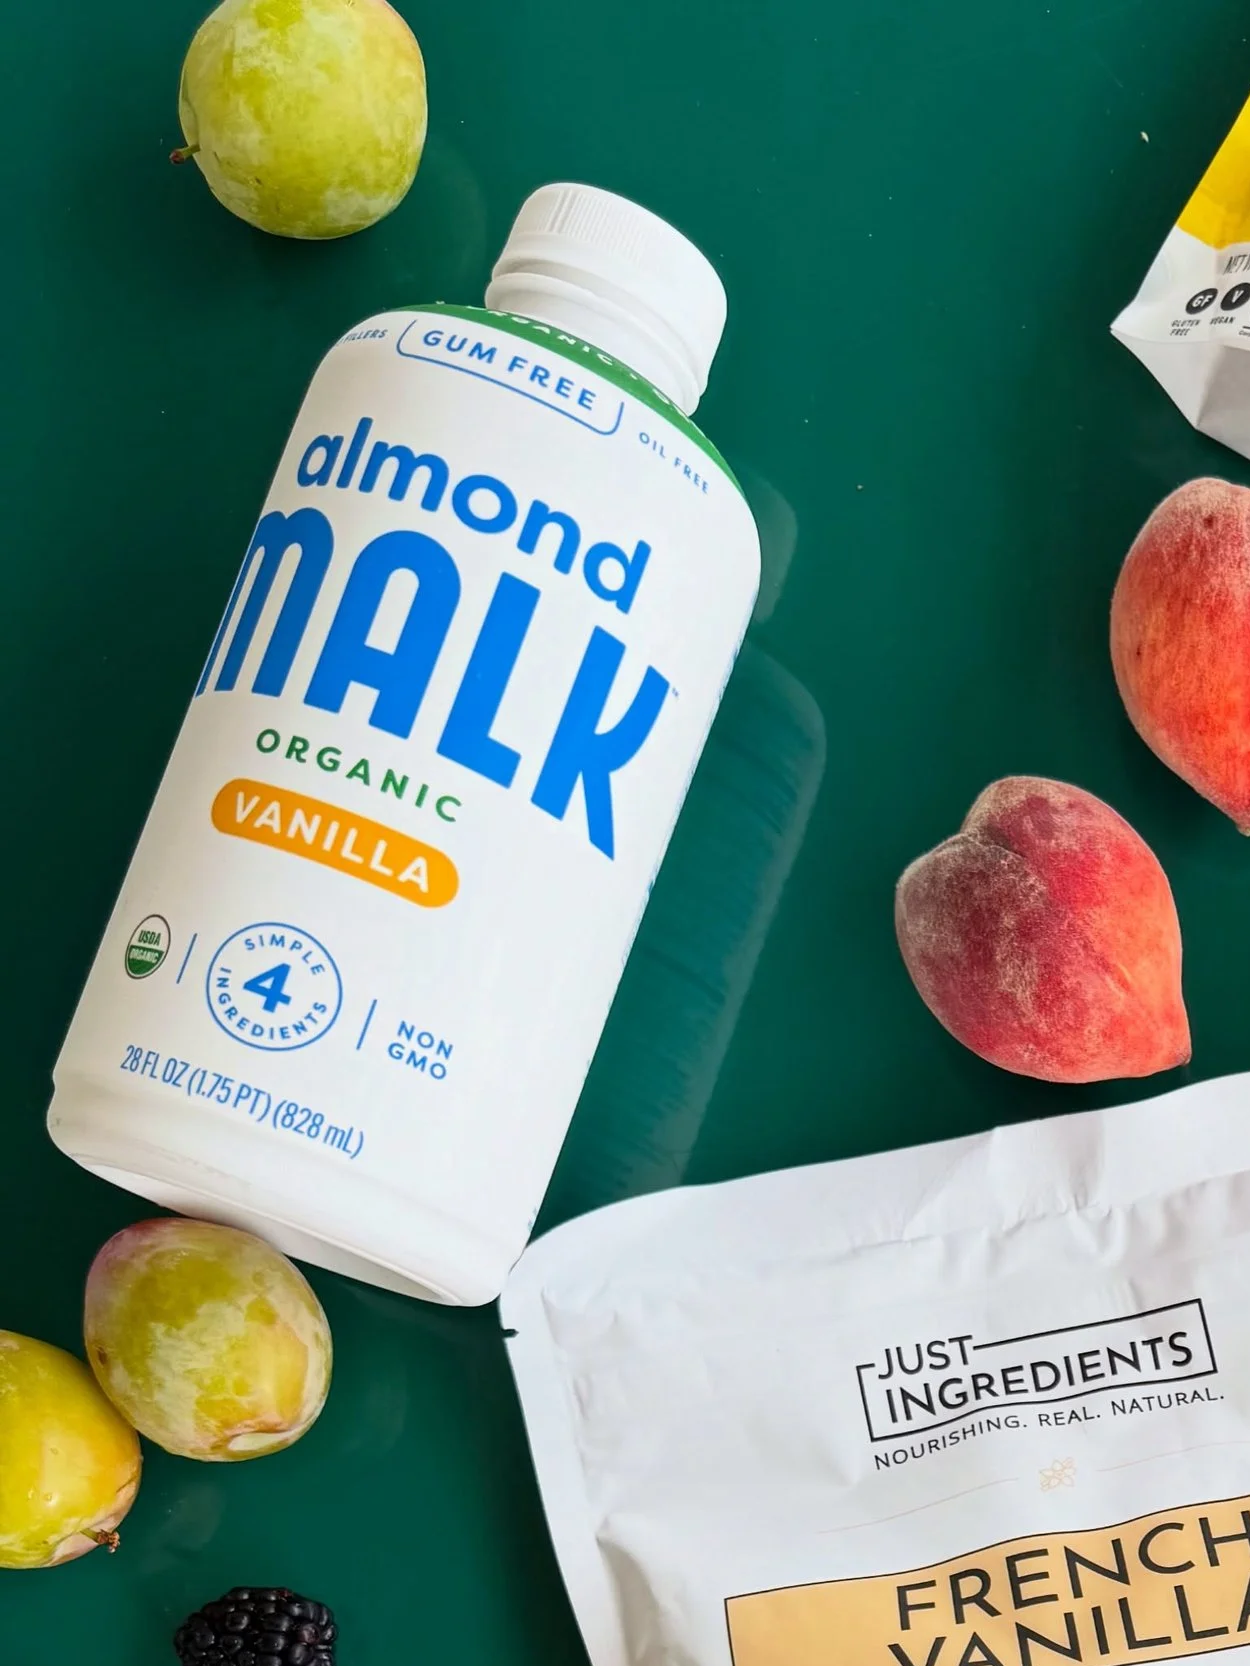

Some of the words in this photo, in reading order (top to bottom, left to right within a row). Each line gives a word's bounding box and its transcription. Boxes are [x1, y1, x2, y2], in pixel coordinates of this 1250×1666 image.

[1192, 294, 1215, 308] GF
[1231, 290, 1244, 304] V
[422, 330, 497, 364] GUM
[507, 355, 597, 411] FREE
[638, 431, 667, 459] OIL
[673, 456, 710, 493] FREE
[296, 416, 652, 615] almond
[194, 506, 671, 862] MALK
[256, 728, 463, 823] ORGANIC
[234, 790, 431, 894] VANILLA
[129, 948, 160, 965] ORGANIC
[138, 929, 161, 946] USDA
[244, 933, 326, 976] SIMPLE
[216, 967, 328, 1040] INGREDIENTS
[242, 962, 292, 1013] 4
[387, 1043, 449, 1081] GMO
[397, 1020, 454, 1061] NON
[120, 1044, 140, 1072] 28
[140, 1049, 161, 1078] FL
[162, 1057, 190, 1088] OZ
[187, 1067, 235, 1104] (1.75
[233, 1082, 271, 1122] PT)
[272, 1099, 324, 1140] (828
[323, 1126, 364, 1159] mL)
[878, 1335, 973, 1380] JUST
[886, 1331, 1193, 1423] INGREDIENTS
[874, 1417, 1028, 1470] NOURISHING.
[1038, 1406, 1101, 1427] REAL.
[1111, 1387, 1225, 1416] NATURAL.
